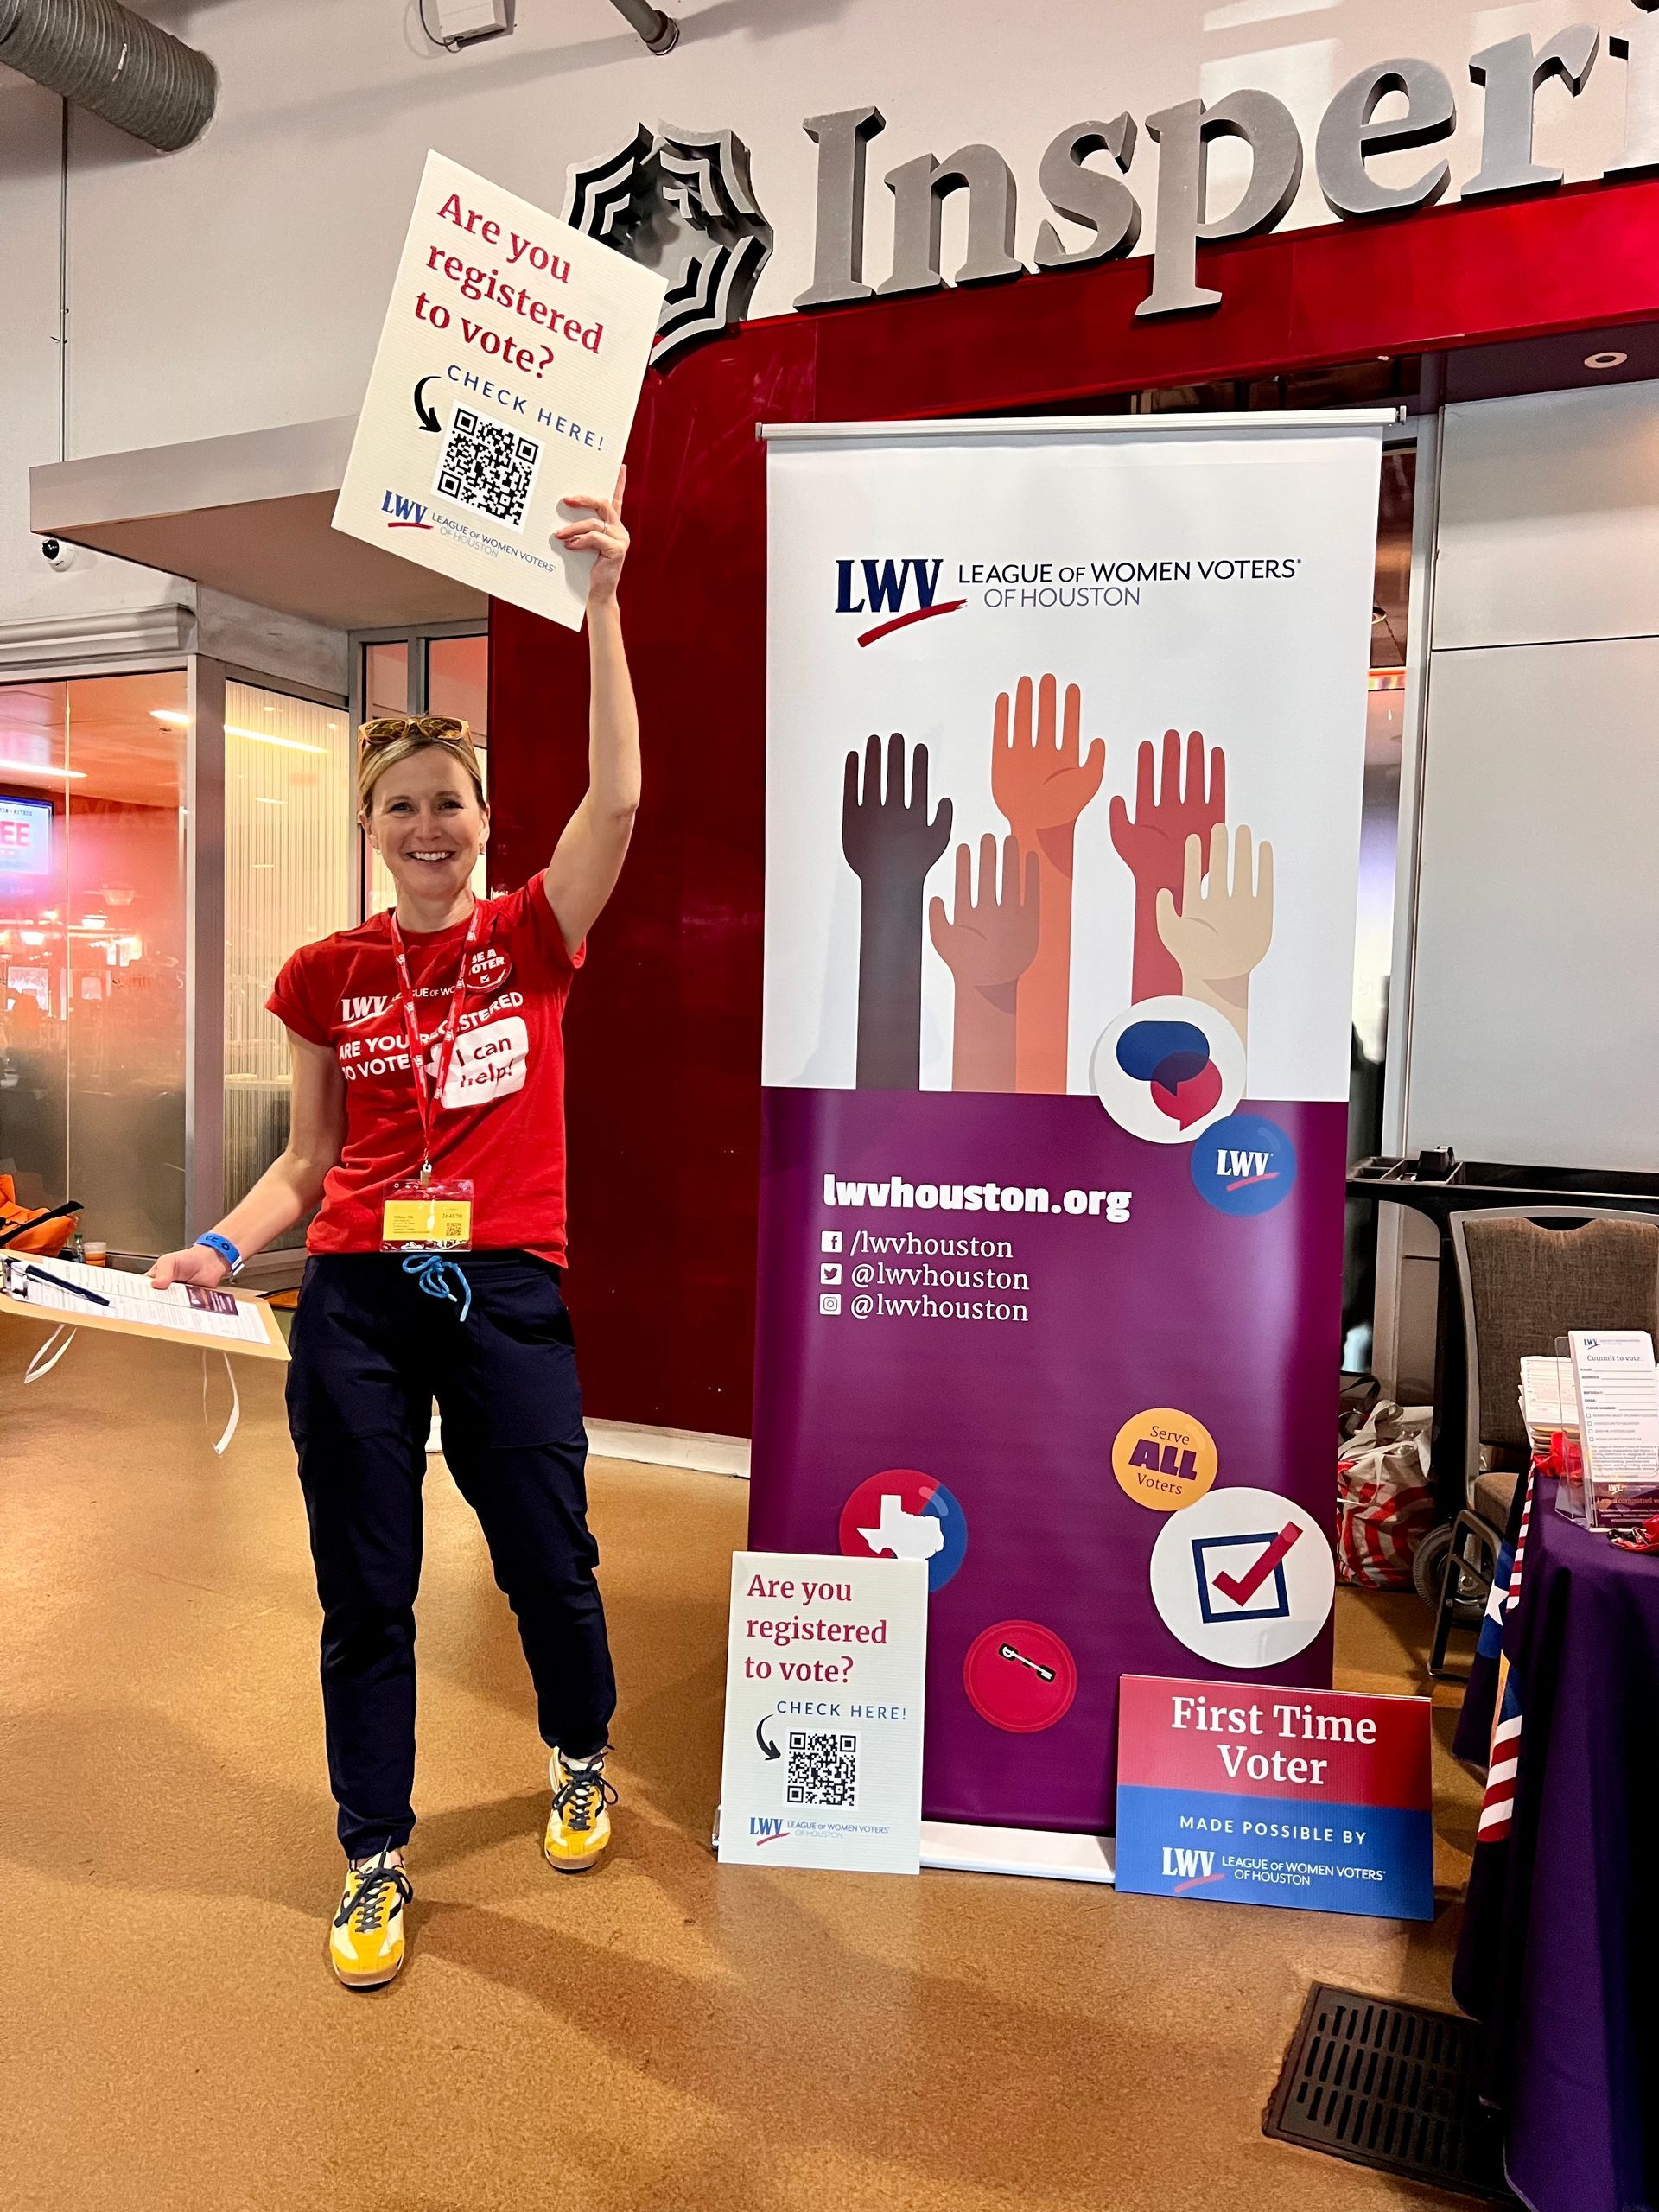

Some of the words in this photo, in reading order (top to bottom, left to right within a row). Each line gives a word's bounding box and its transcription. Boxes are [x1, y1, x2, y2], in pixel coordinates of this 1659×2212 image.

[435, 193, 499, 245] Are
[506, 231, 571, 284] you
[425, 245, 604, 355] registered
[415, 291, 450, 330] to
[461, 315, 555, 378] vote?
[447, 365, 525, 415] CHECK
[537, 408, 605, 451] HERE!
[381, 490, 428, 524] LWV
[432, 512, 468, 535] LEAGUE
[469, 531, 480, 539] OF
[481, 534, 518, 556] WOMEN
[440, 527, 453, 539] OF
[454, 532, 499, 558] HOUSTON
[835, 558, 944, 613] LWV
[958, 563, 1052, 584] LEAGUE
[1058, 567, 1086, 582] OF
[1090, 561, 1192, 582] WOMEN
[983, 588, 1016, 608] OF
[1021, 587, 1141, 607] HOUSTON
[468, 956, 505, 976] OTER
[487, 948, 497, 959] A
[341, 995, 388, 1021] LWV
[339, 1040, 361, 1060] ARE
[365, 1034, 410, 1053] YOU
[455, 1048, 466, 1067] I
[474, 1036, 512, 1061] can
[1216, 1149, 1271, 1177] LWV
[823, 1174, 1133, 1223] lwvhouston.org
[849, 1230, 1014, 1259] /lwvhouston
[850, 1262, 1030, 1291] @lwvhouston
[849, 1293, 1029, 1322] @lwvhouston
[1150, 1425, 1190, 1445] Serve
[1128, 1438, 1198, 1481] ALL
[1137, 1472, 1183, 1495] Voters
[747, 1574, 794, 1599] Are
[802, 1582, 852, 1605] you
[746, 1617, 887, 1646] registered
[744, 1656, 772, 1679] to
[779, 1656, 854, 1683] vote?
[776, 1700, 841, 1717] CHECK
[850, 1705, 907, 1720] HERE!
[1172, 1696, 1264, 1735] First
[1272, 1704, 1376, 1745] Time
[1217, 1744, 1328, 1785] Voter
[750, 1817, 784, 1836] LWV
[787, 1821, 817, 1829] LEAGUE
[806, 1830, 843, 1839] HOUSTON
[1180, 1815, 1234, 1833] MADE
[1243, 1821, 1334, 1842] POSSIBLE
[1344, 1831, 1367, 1845] BY
[1161, 1847, 1216, 1878] LWV
[1222, 1855, 1268, 1871] LEAGUE
[1270, 1861, 1284, 1872] OF
[1286, 1861, 1334, 1877] WOMEN
[1234, 1870, 1251, 1880] OF
[1251, 1870, 1311, 1886] HOUSTON
